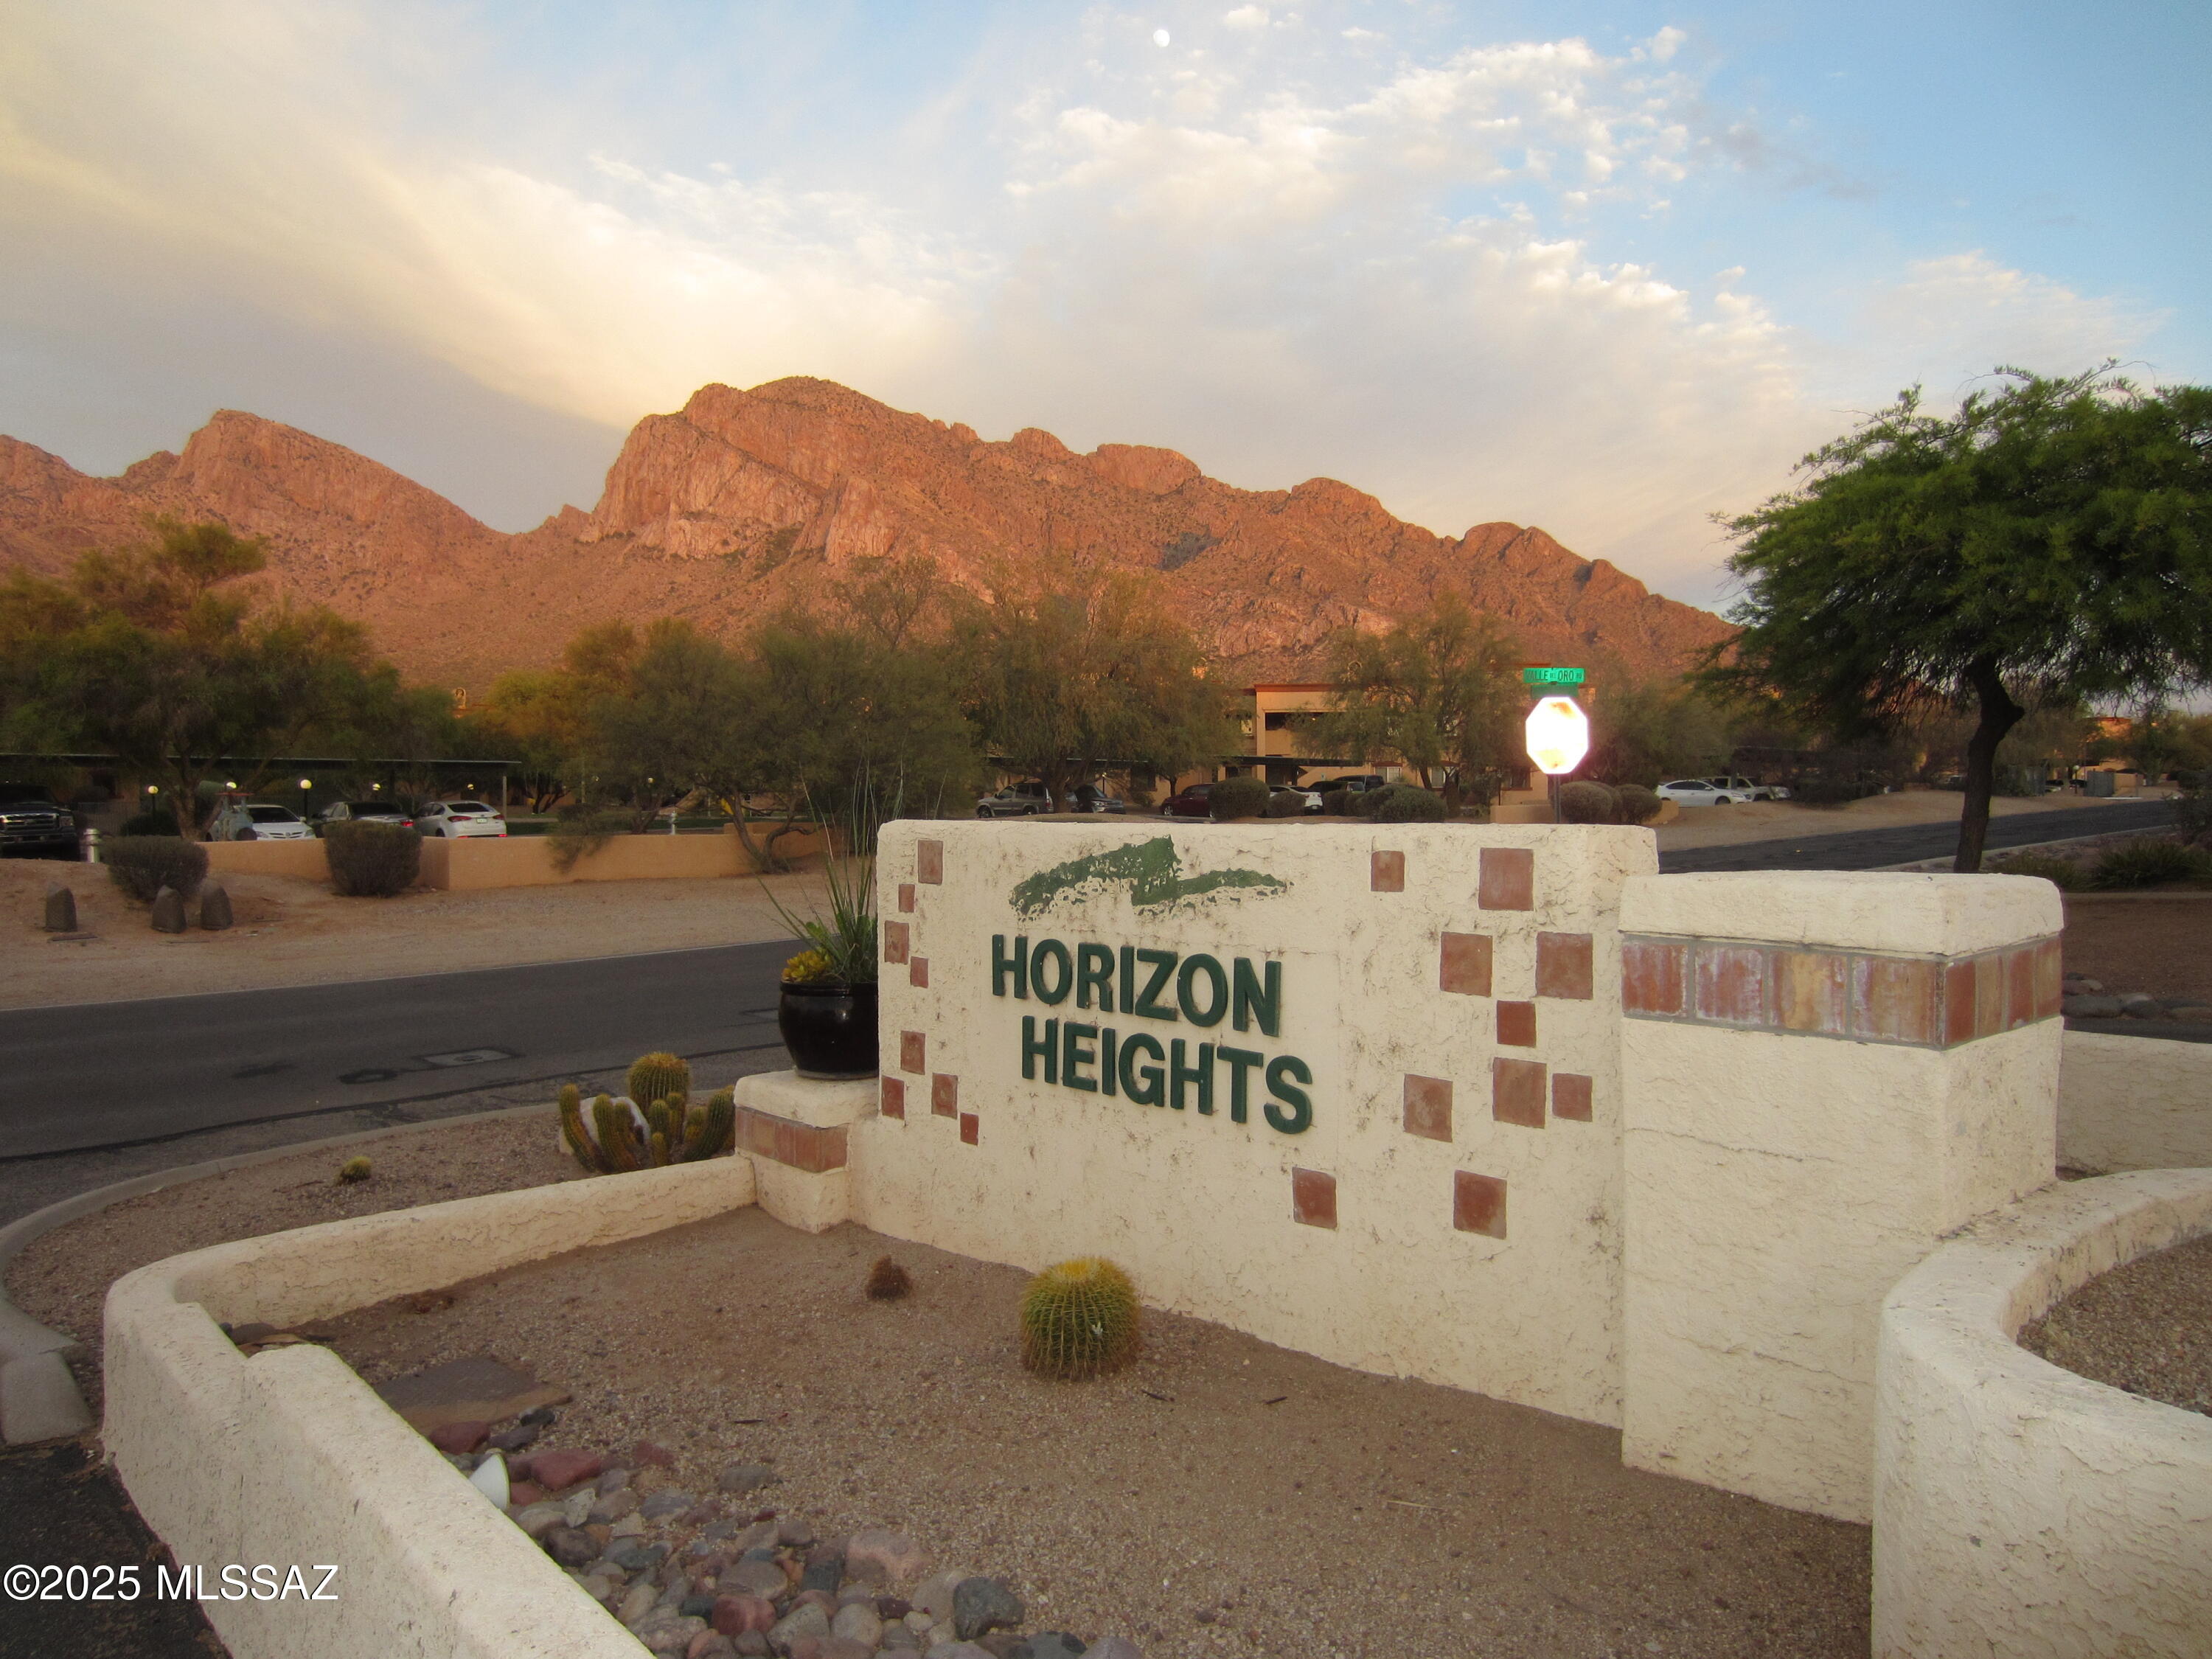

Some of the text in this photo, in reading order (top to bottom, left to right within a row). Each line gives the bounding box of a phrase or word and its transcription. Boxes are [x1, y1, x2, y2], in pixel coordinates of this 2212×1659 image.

[1558, 670, 1574, 681] ORO
[992, 933, 1281, 1037] HORIZON
[1022, 1015, 1312, 1134] HEIGHTS
